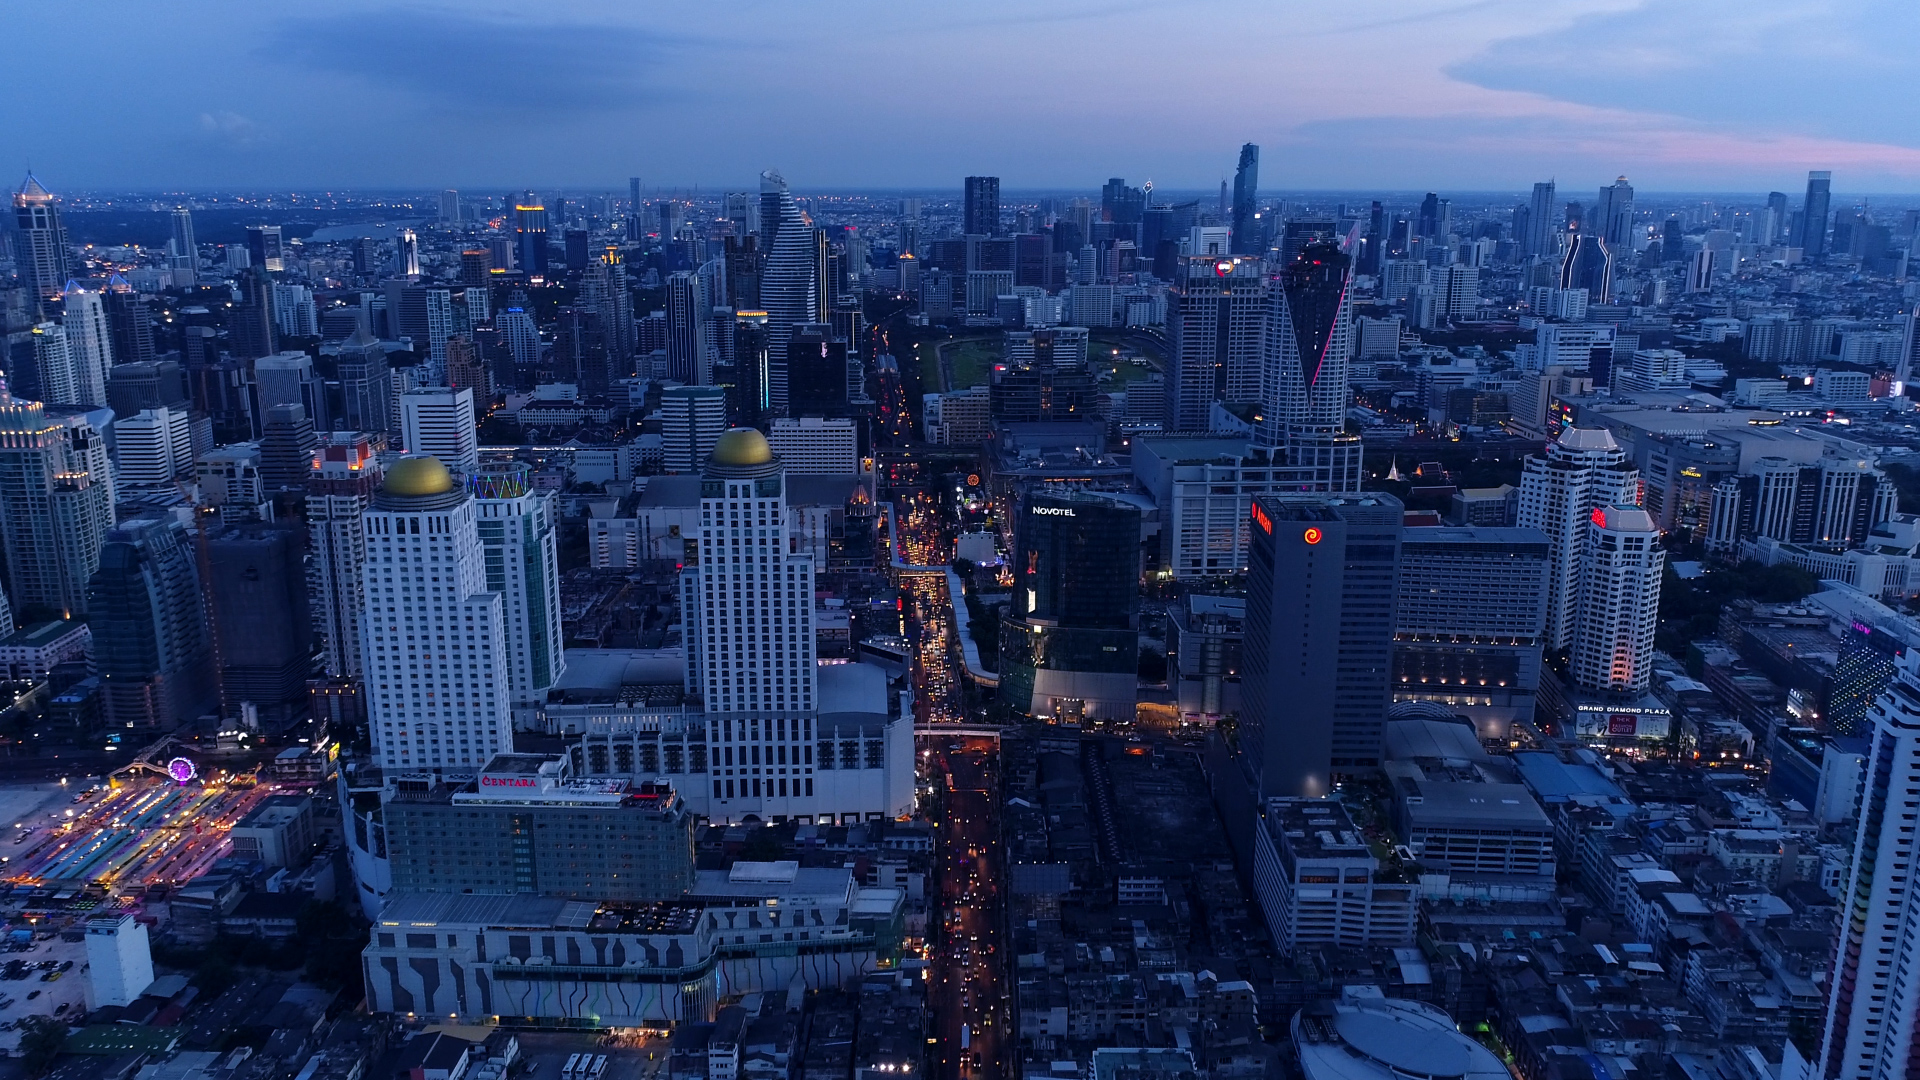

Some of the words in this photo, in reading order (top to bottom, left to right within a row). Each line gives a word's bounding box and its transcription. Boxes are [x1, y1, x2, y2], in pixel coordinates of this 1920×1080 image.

[1032, 506, 1076, 517] NOVOTEL
[1606, 706, 1642, 714] DIAMOND
[481, 775, 537, 787] CENTARA
